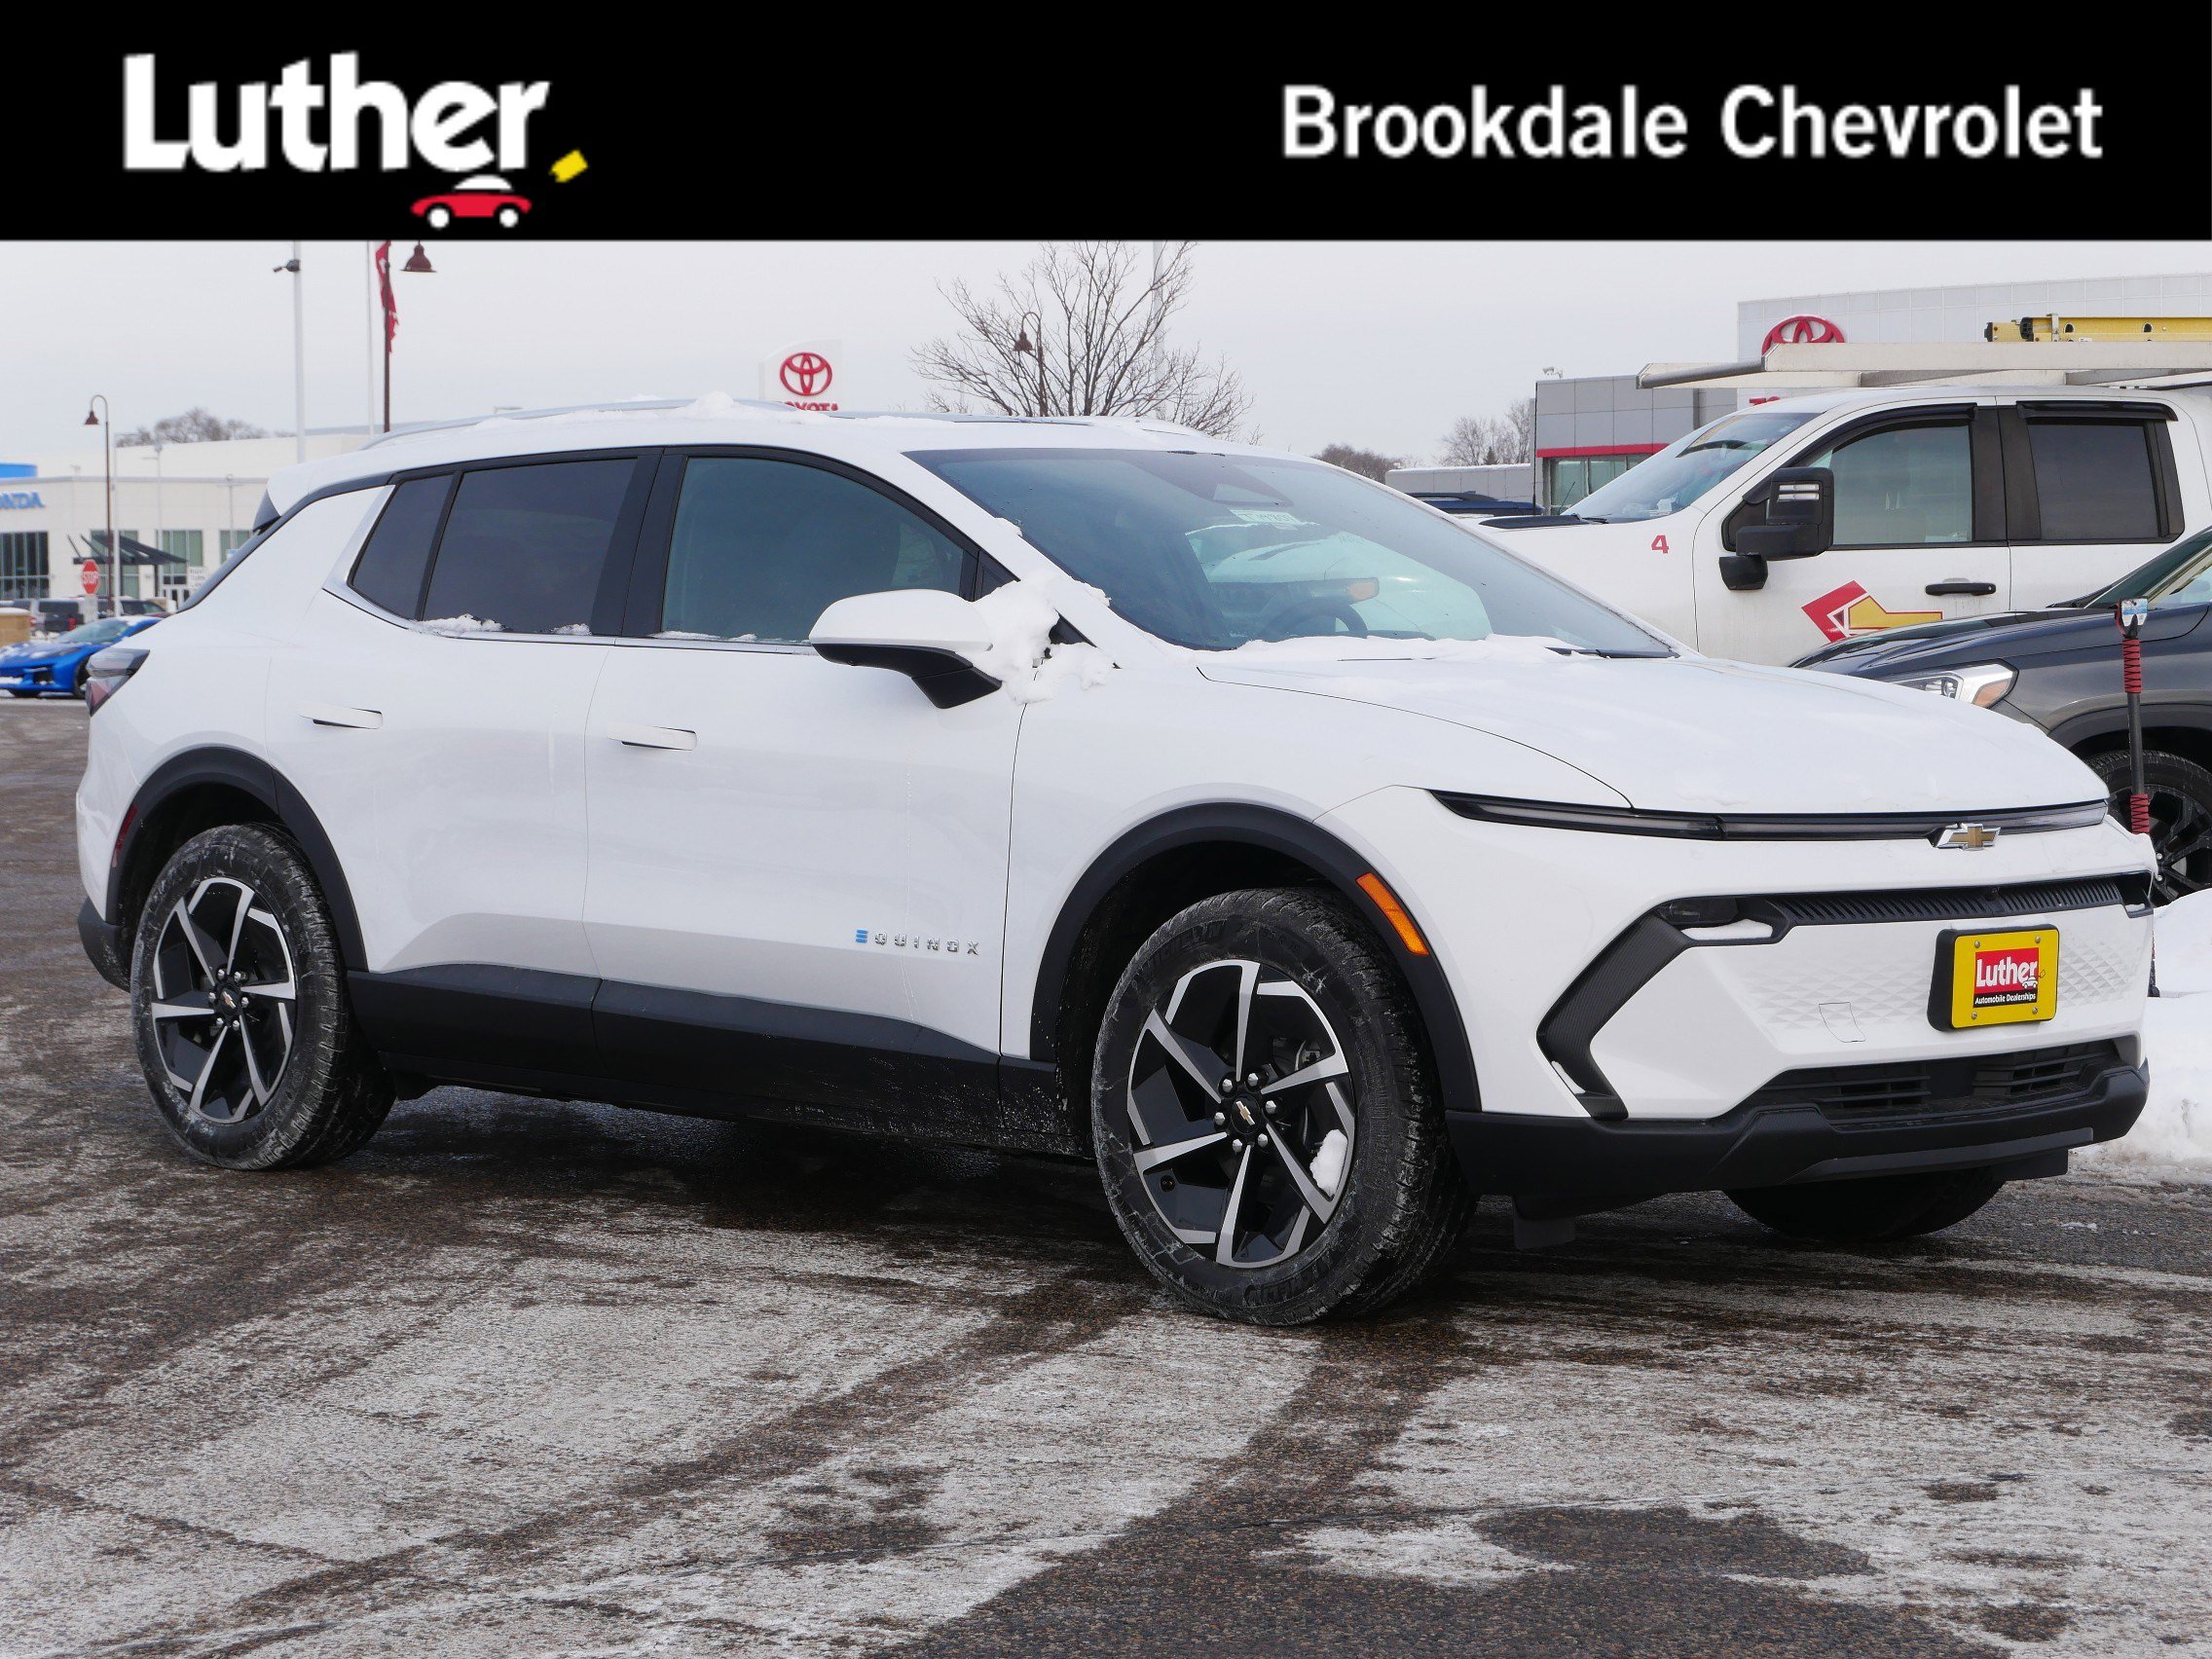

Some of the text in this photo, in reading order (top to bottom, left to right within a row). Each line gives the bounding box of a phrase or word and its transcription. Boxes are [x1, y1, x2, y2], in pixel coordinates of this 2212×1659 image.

[783, 400, 839, 411] YOTA
[1651, 535, 1670, 554] 4
[83, 571, 98, 584] STOP
[856, 928, 979, 956] EQUINOX
[1975, 956, 2039, 987] Luther
[1974, 992, 2036, 1005] Automobile Dealerships
